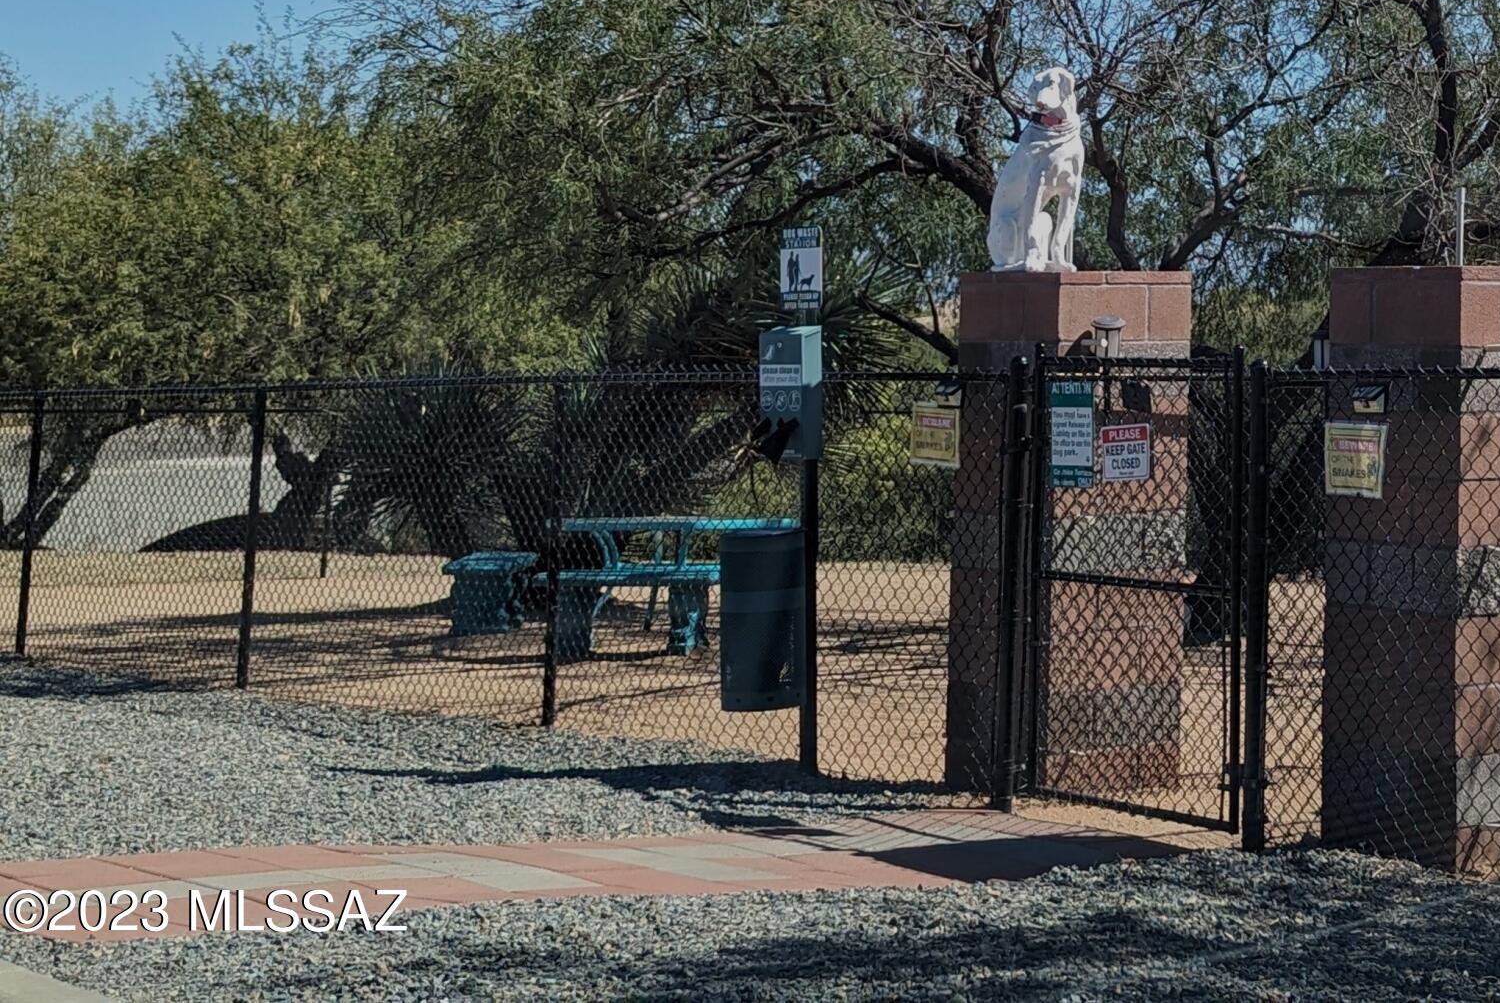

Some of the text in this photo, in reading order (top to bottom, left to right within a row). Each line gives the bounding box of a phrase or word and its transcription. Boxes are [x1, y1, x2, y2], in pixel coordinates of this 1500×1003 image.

[785, 238, 817, 247] STATION
[1109, 428, 1141, 441] PLEASE
[1105, 442, 1146, 456] KEEP GATE
[1111, 457, 1141, 470] CLOSED
[1332, 468, 1366, 479] SNAKES
